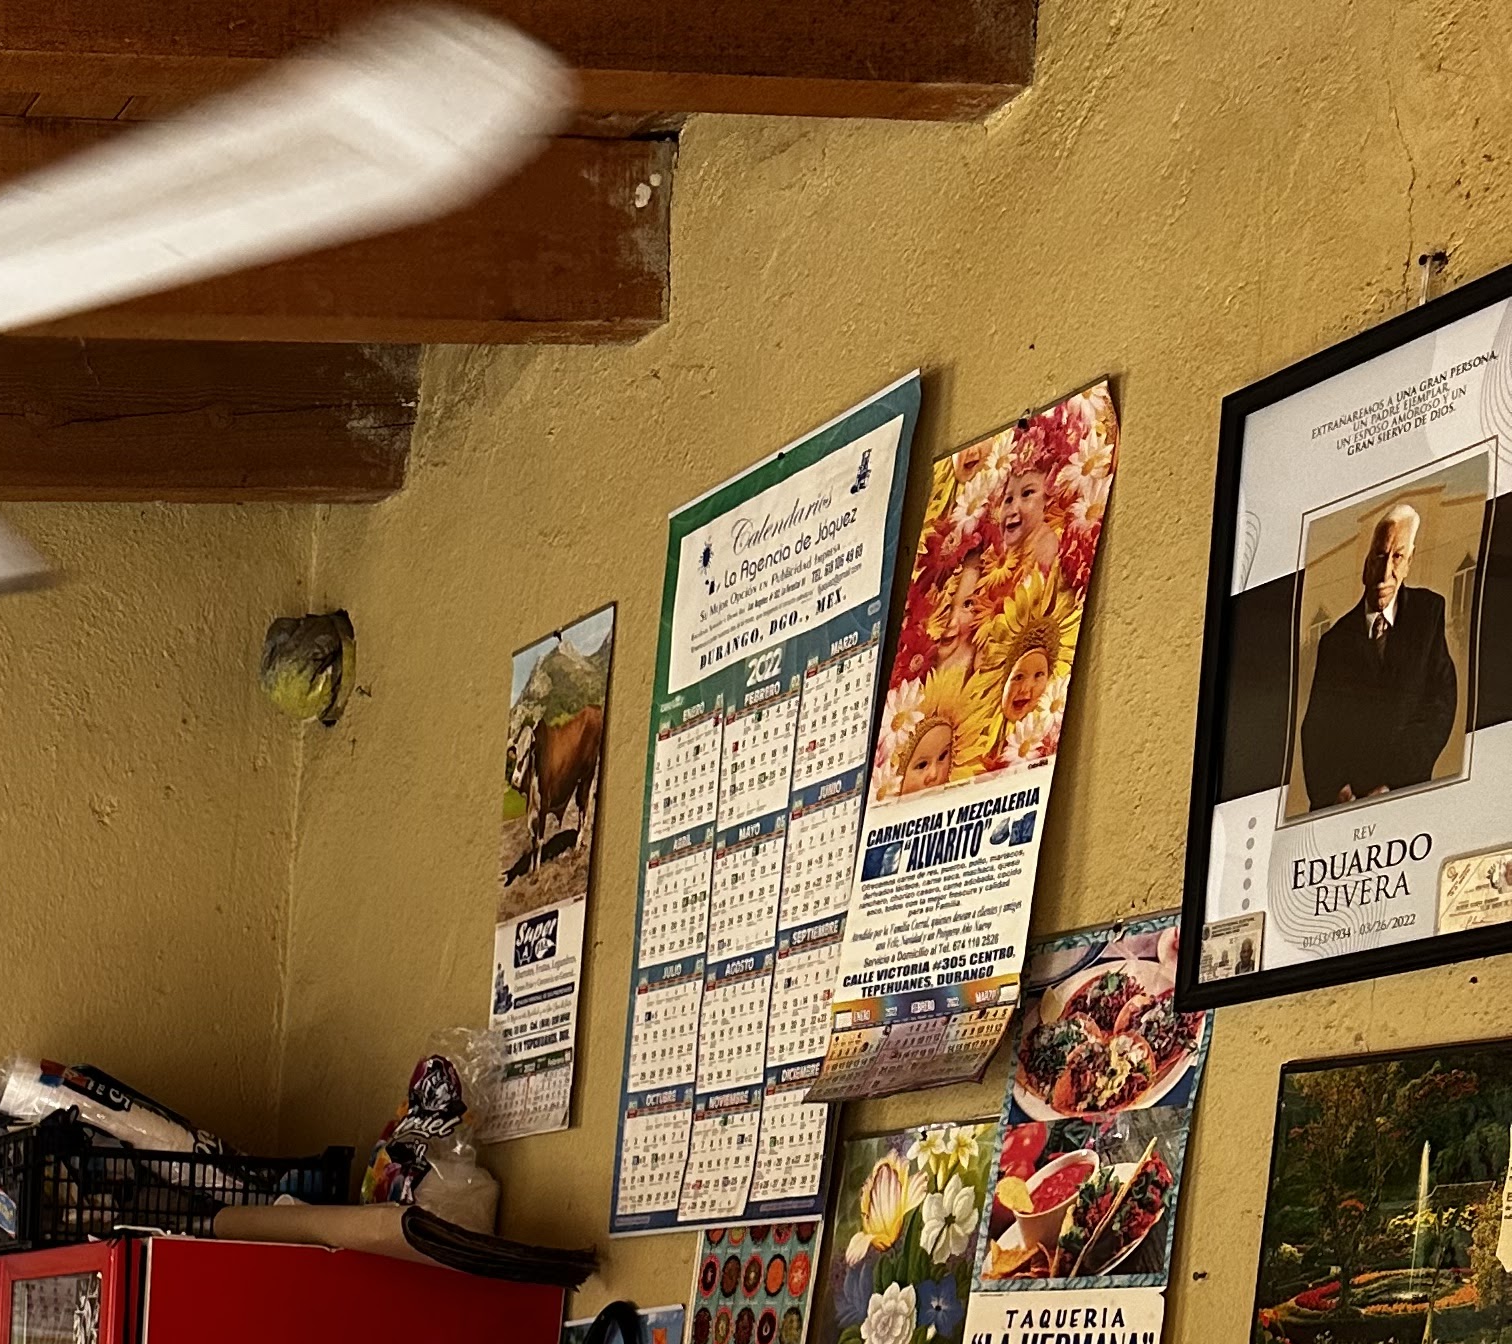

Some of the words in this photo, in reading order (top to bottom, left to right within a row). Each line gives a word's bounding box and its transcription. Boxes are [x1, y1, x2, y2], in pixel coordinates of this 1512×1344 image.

[1311, 399, 1385, 440] EXTRAÑAREMOS
[1387, 395, 1393, 406] A
[1396, 385, 1417, 403] UNA
[1419, 371, 1447, 393] GRAN
[1336, 434, 1351, 450] UN
[1354, 418, 1389, 443] ESPOSO
[1390, 399, 1441, 428] AMOROSO
[1442, 392, 1448, 404] Y
[1450, 384, 1468, 401] UN
[1353, 418, 1367, 432] UN
[1370, 404, 1401, 425] PADRE
[1347, 437, 1375, 456] GRAN
[1377, 421, 1411, 445] SIERVO
[1414, 414, 1428, 428] DE
[725, 570, 736, 588] La
[740, 545, 790, 581] Agencia
[795, 532, 811, 554] de
[699, 627, 764, 670] DURANGO,
[816, 586, 847, 615] MEX.
[746, 648, 783, 687] 2022
[867, 812, 943, 847] CARNICERIA
[946, 808, 955, 827] Y
[956, 787, 1040, 823] MEZCALERIA
[1353, 824, 1377, 842] REV
[1292, 832, 1433, 890] EDUARDO
[1314, 870, 1411, 916] RIVERA
[843, 971, 873, 988] CALLE
[876, 961, 930, 981] VICTORIA
[932, 955, 966, 971] #305
[969, 946, 1016, 966] CENTRO,
[936, 965, 994, 986] DURANGO
[1006, 1307, 1125, 1330] TAQUERIA
